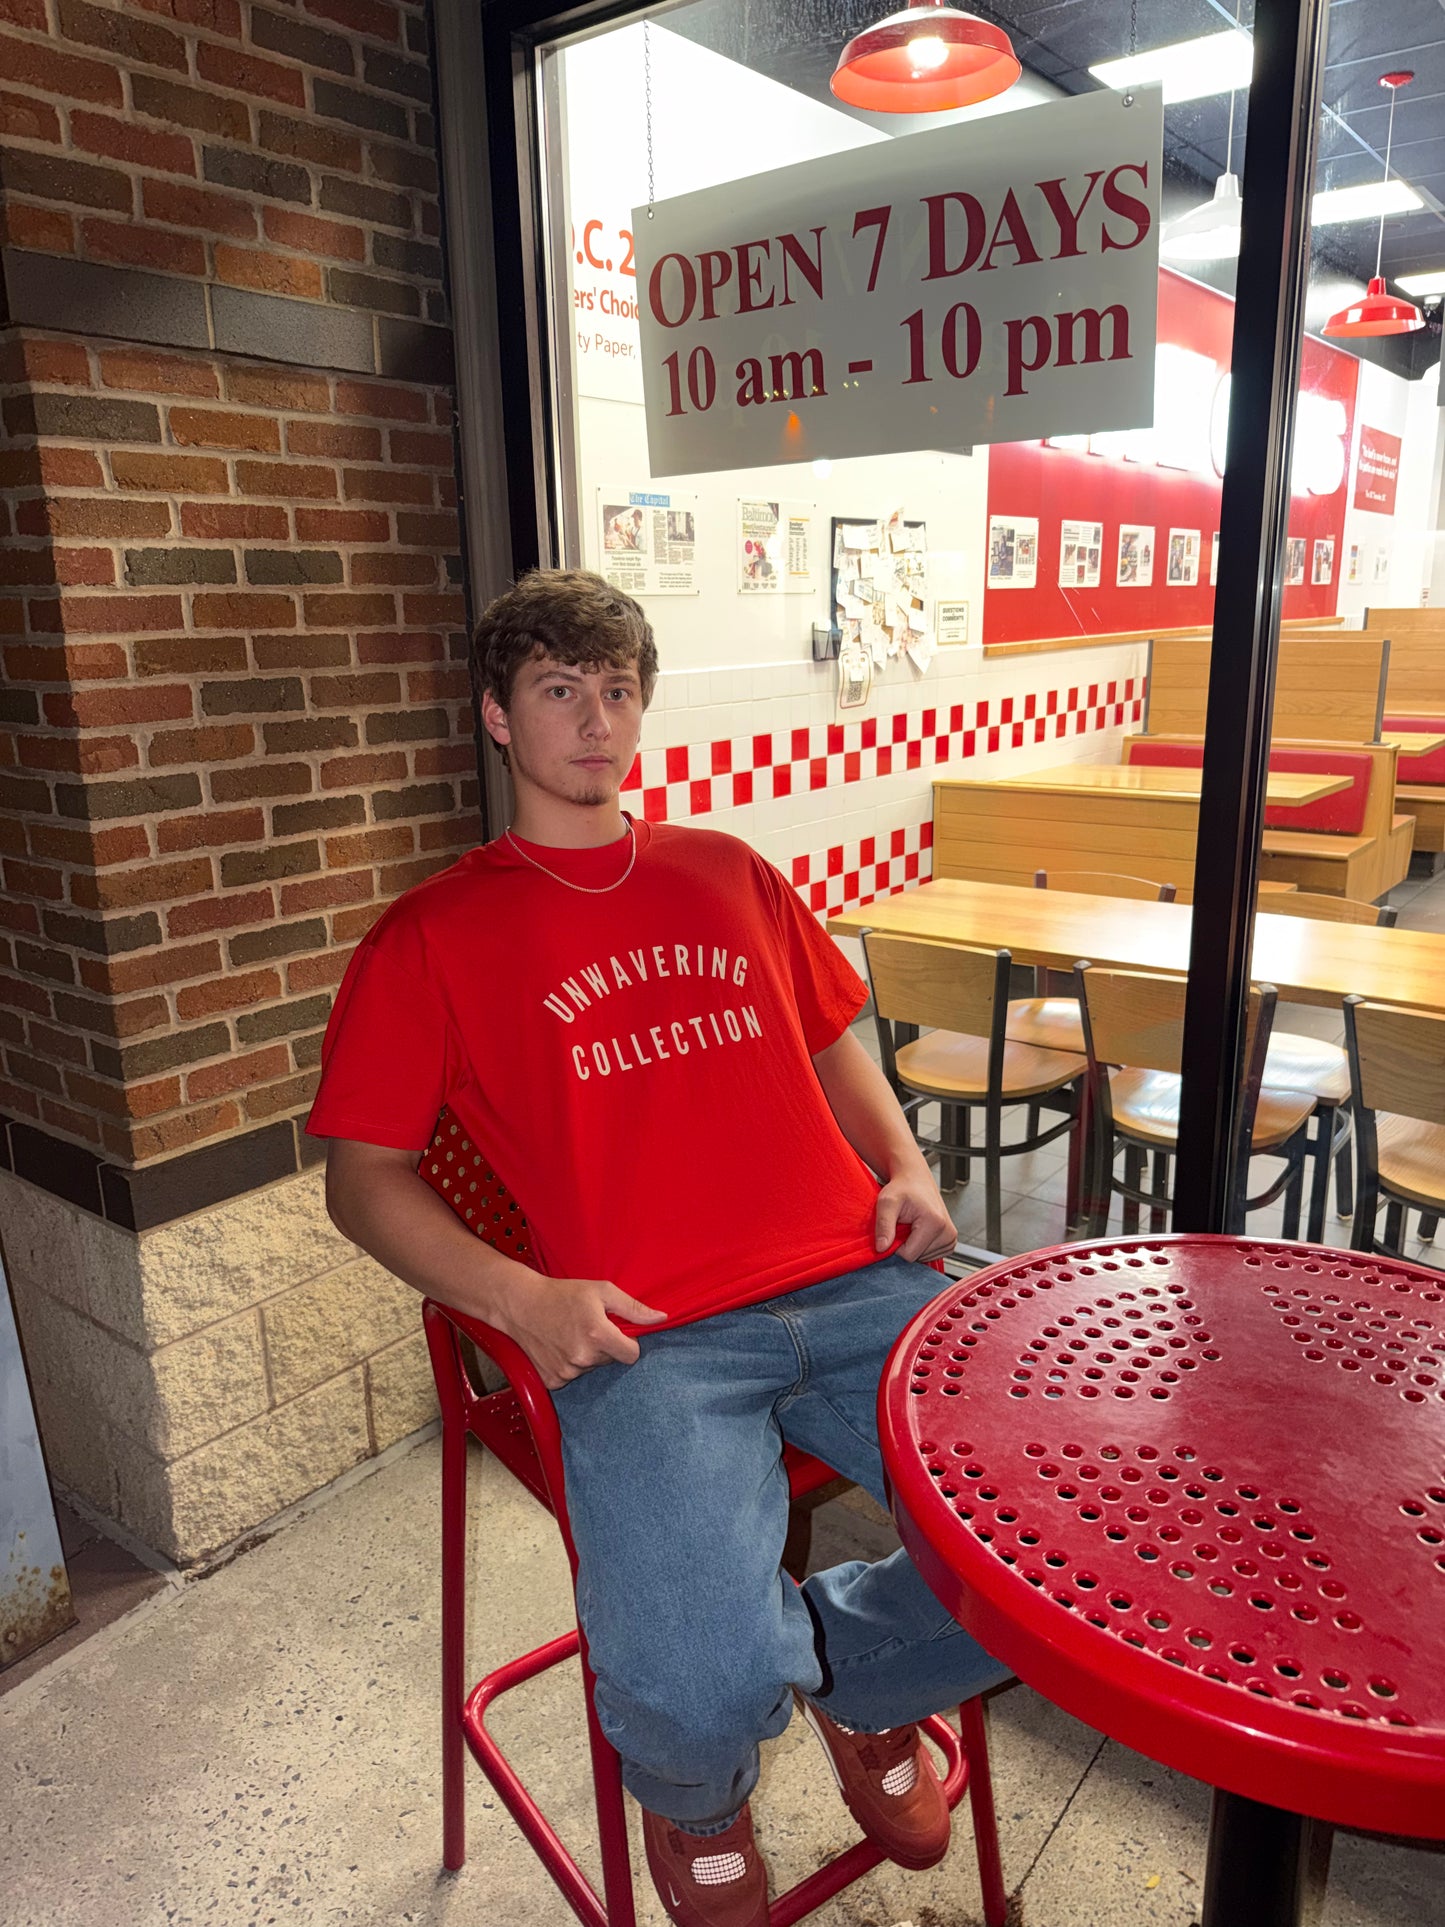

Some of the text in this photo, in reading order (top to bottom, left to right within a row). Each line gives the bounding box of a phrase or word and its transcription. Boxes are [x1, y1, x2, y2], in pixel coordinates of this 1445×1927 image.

[572, 219, 613, 272] .C.
[648, 160, 1151, 329] OPEN 7 DAYS
[595, 333, 636, 359] Paper,
[661, 302, 1133, 417] 10 am - 10 pm
[543, 944, 748, 1024] UNWAVERING
[572, 1005, 763, 1081] COLLECTION
